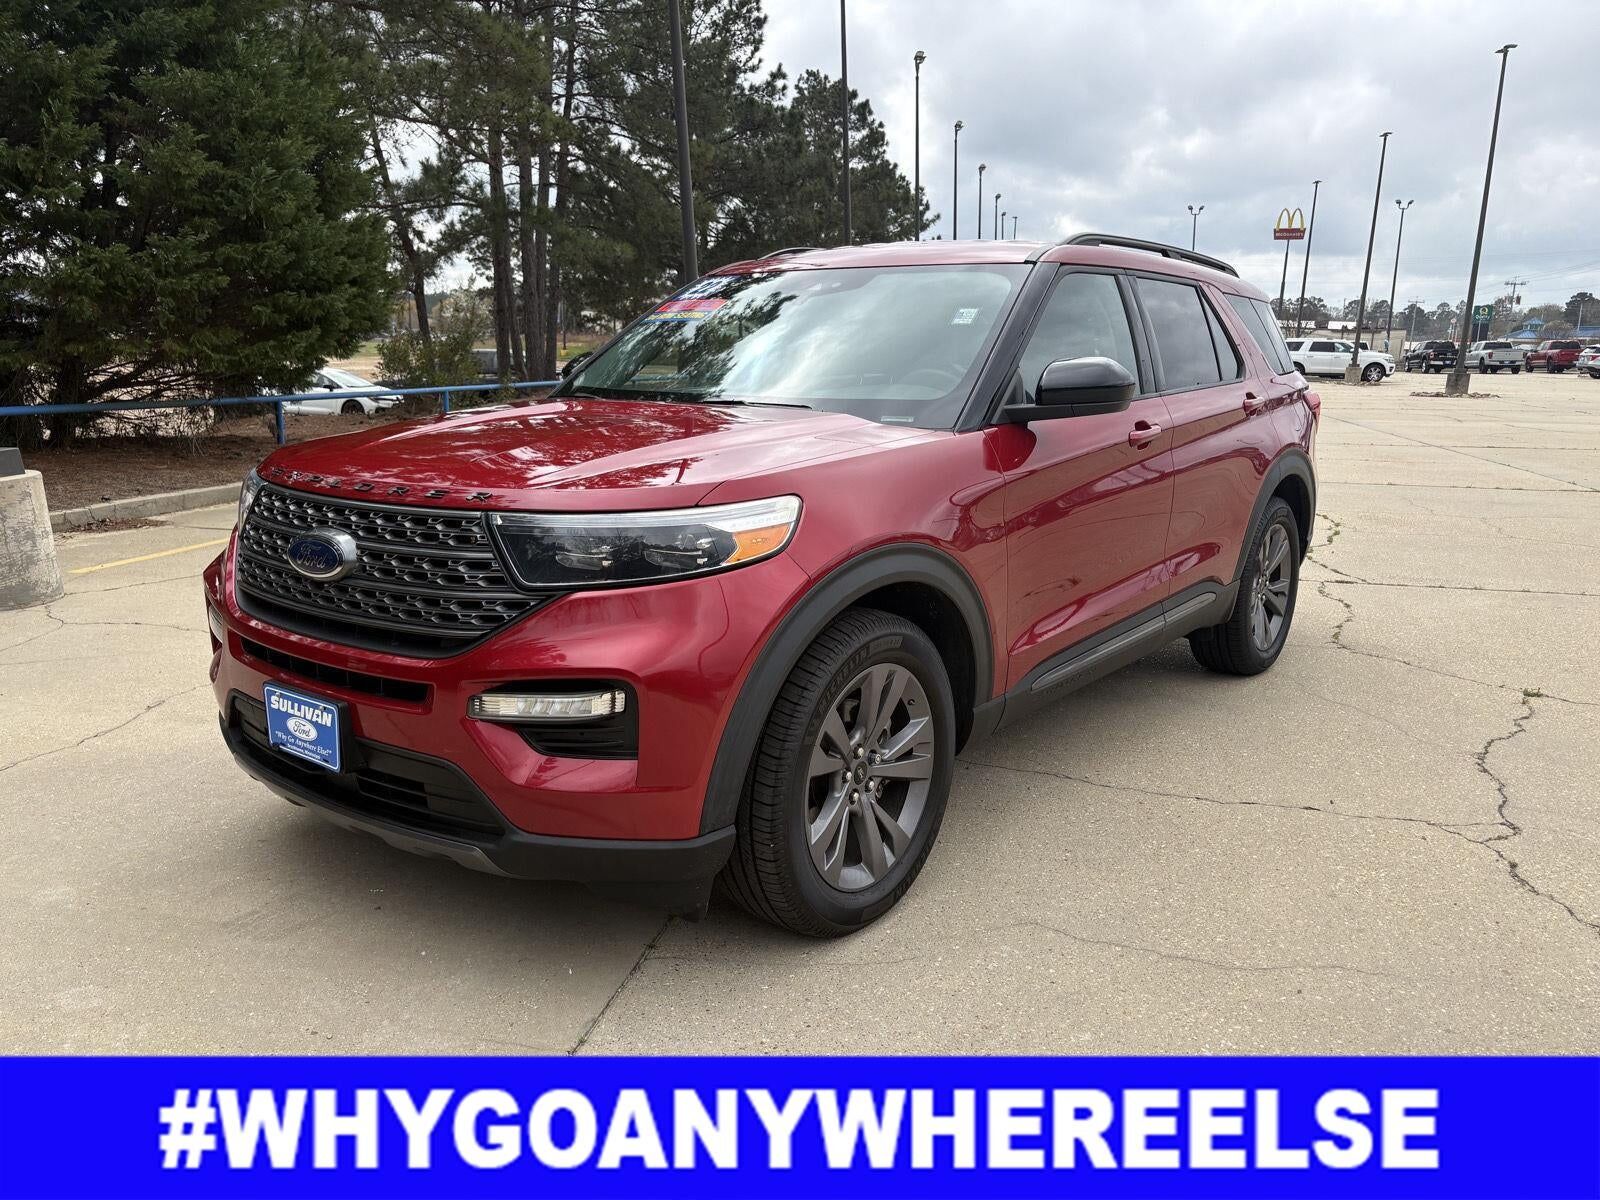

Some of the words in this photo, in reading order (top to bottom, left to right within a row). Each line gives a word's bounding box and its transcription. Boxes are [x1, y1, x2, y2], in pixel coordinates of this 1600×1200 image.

[296, 544, 327, 569] Ford
[270, 695, 333, 727] SULLIVAN
[292, 720, 312, 738] Ford
